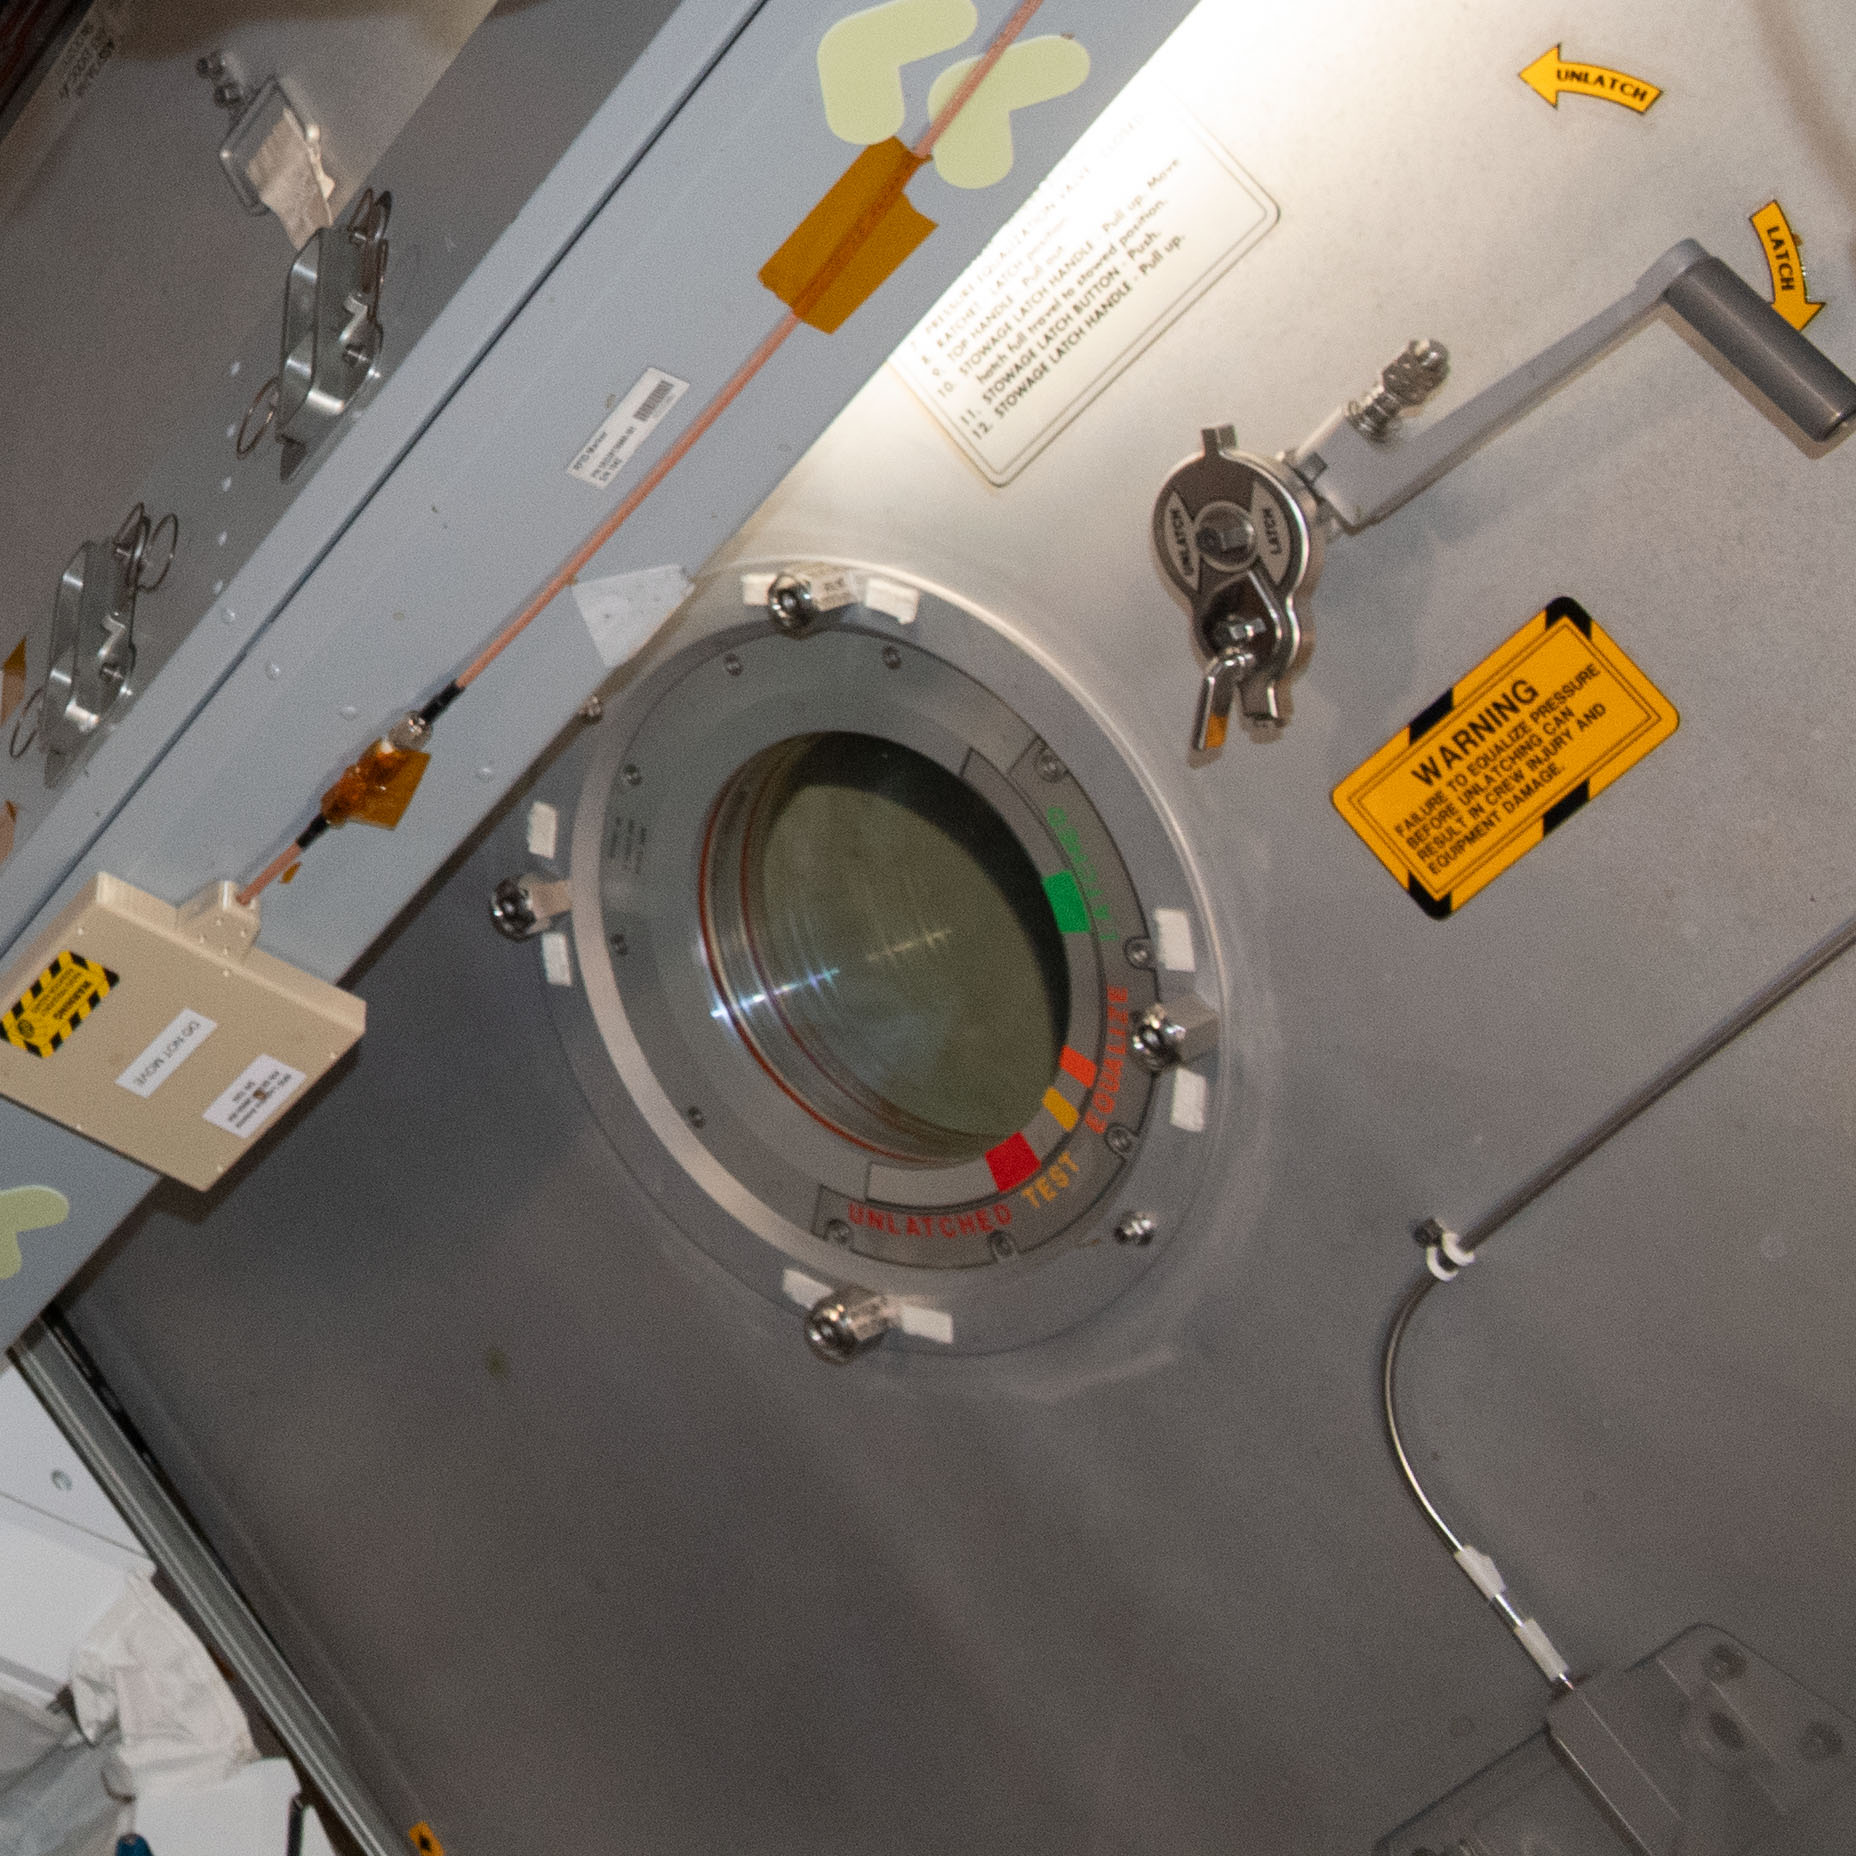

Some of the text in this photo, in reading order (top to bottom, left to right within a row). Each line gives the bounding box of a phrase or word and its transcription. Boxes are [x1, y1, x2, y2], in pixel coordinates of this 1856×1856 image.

[1555, 68, 1647, 101] UNLATCH
[937, 378, 958, 399] 10.
[956, 319, 1015, 377] STOWAGE
[1010, 283, 1051, 324] LATCH
[1046, 239, 1097, 288] HANDLE
[1101, 208, 1128, 235] Pull
[1145, 156, 1182, 192] Move
[945, 335, 973, 364] TOP
[968, 293, 1016, 340] HANDLE
[1021, 263, 1046, 288] Pull
[974, 194, 1170, 385] hatch full travel to stowed position.
[1766, 225, 1794, 291] LATCH
[959, 225, 1163, 427] 11. STOWAGE LATCH BUTTON Push.
[971, 230, 1188, 441] 12. STOWAGE LATCH HANDLE Pull up.
[1168, 507, 1194, 576] UNLATCH
[1261, 508, 1282, 555] LATCH
[1392, 662, 1600, 838] FAILURE TO EQUALIZE PRESSURE
[1405, 705, 1575, 850] BEFORE UNLATCHING CAN
[1410, 675, 1540, 788] WARNING
[1415, 700, 1608, 863] RESULT IN CREW INJURY AND
[1426, 758, 1566, 876] EQUIPMENT DAMAGE.
[52, 979, 93, 1021] WARNING
[131, 1020, 201, 1087] DO NOT MOVE
[1083, 985, 1127, 1134] EQUALIZE
[847, 1203, 1012, 1238] UNLATCHED
[1019, 1149, 1081, 1208] TEST
